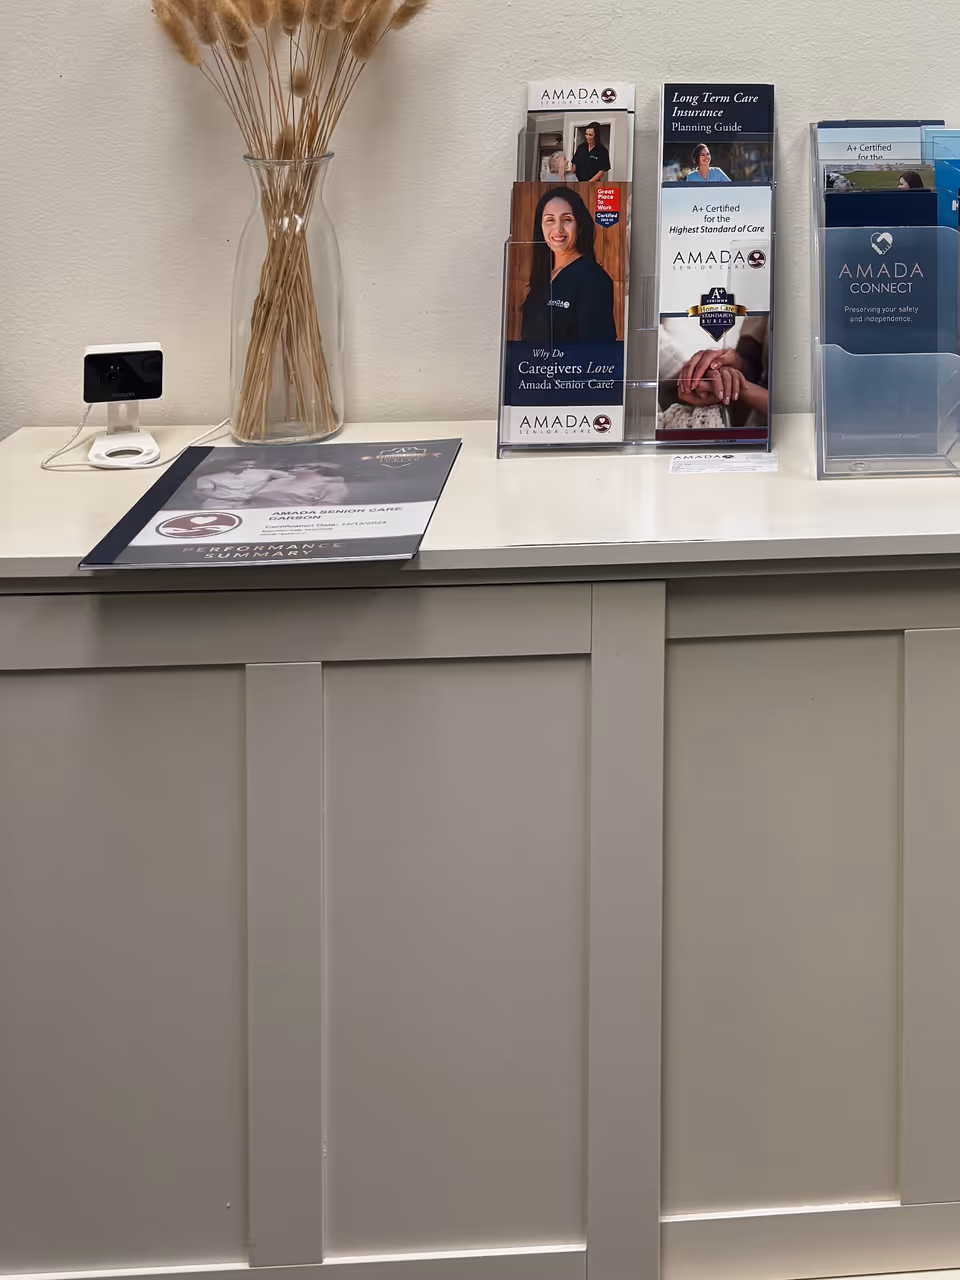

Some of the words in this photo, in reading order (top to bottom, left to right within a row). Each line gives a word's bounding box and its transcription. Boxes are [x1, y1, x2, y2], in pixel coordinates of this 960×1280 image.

[541, 88, 599, 100] AMADA
[672, 92, 699, 104] Long
[702, 92, 731, 103] Term
[733, 92, 759, 103] Care
[671, 107, 723, 118] Insurance
[671, 122, 712, 133] Planning
[714, 122, 742, 132] Guide
[705, 204, 740, 212] Certified
[669, 226, 699, 235] Highest
[700, 225, 736, 233] Standard
[737, 225, 747, 233] of
[673, 250, 745, 264] AMADA
[839, 262, 924, 278] AMADA
[712, 288, 724, 298] A+
[850, 283, 912, 293] CONNECT
[533, 349, 550, 360] Why
[552, 349, 565, 358] Do
[518, 361, 582, 378] Caregivers
[586, 362, 615, 374] Love
[518, 380, 551, 389] Amada
[555, 380, 585, 389] Senior
[588, 379, 614, 389] Care?
[520, 415, 591, 428] AMADA
[182, 543, 343, 552] PERFORMANCE
[205, 550, 312, 559] SUMMARY
